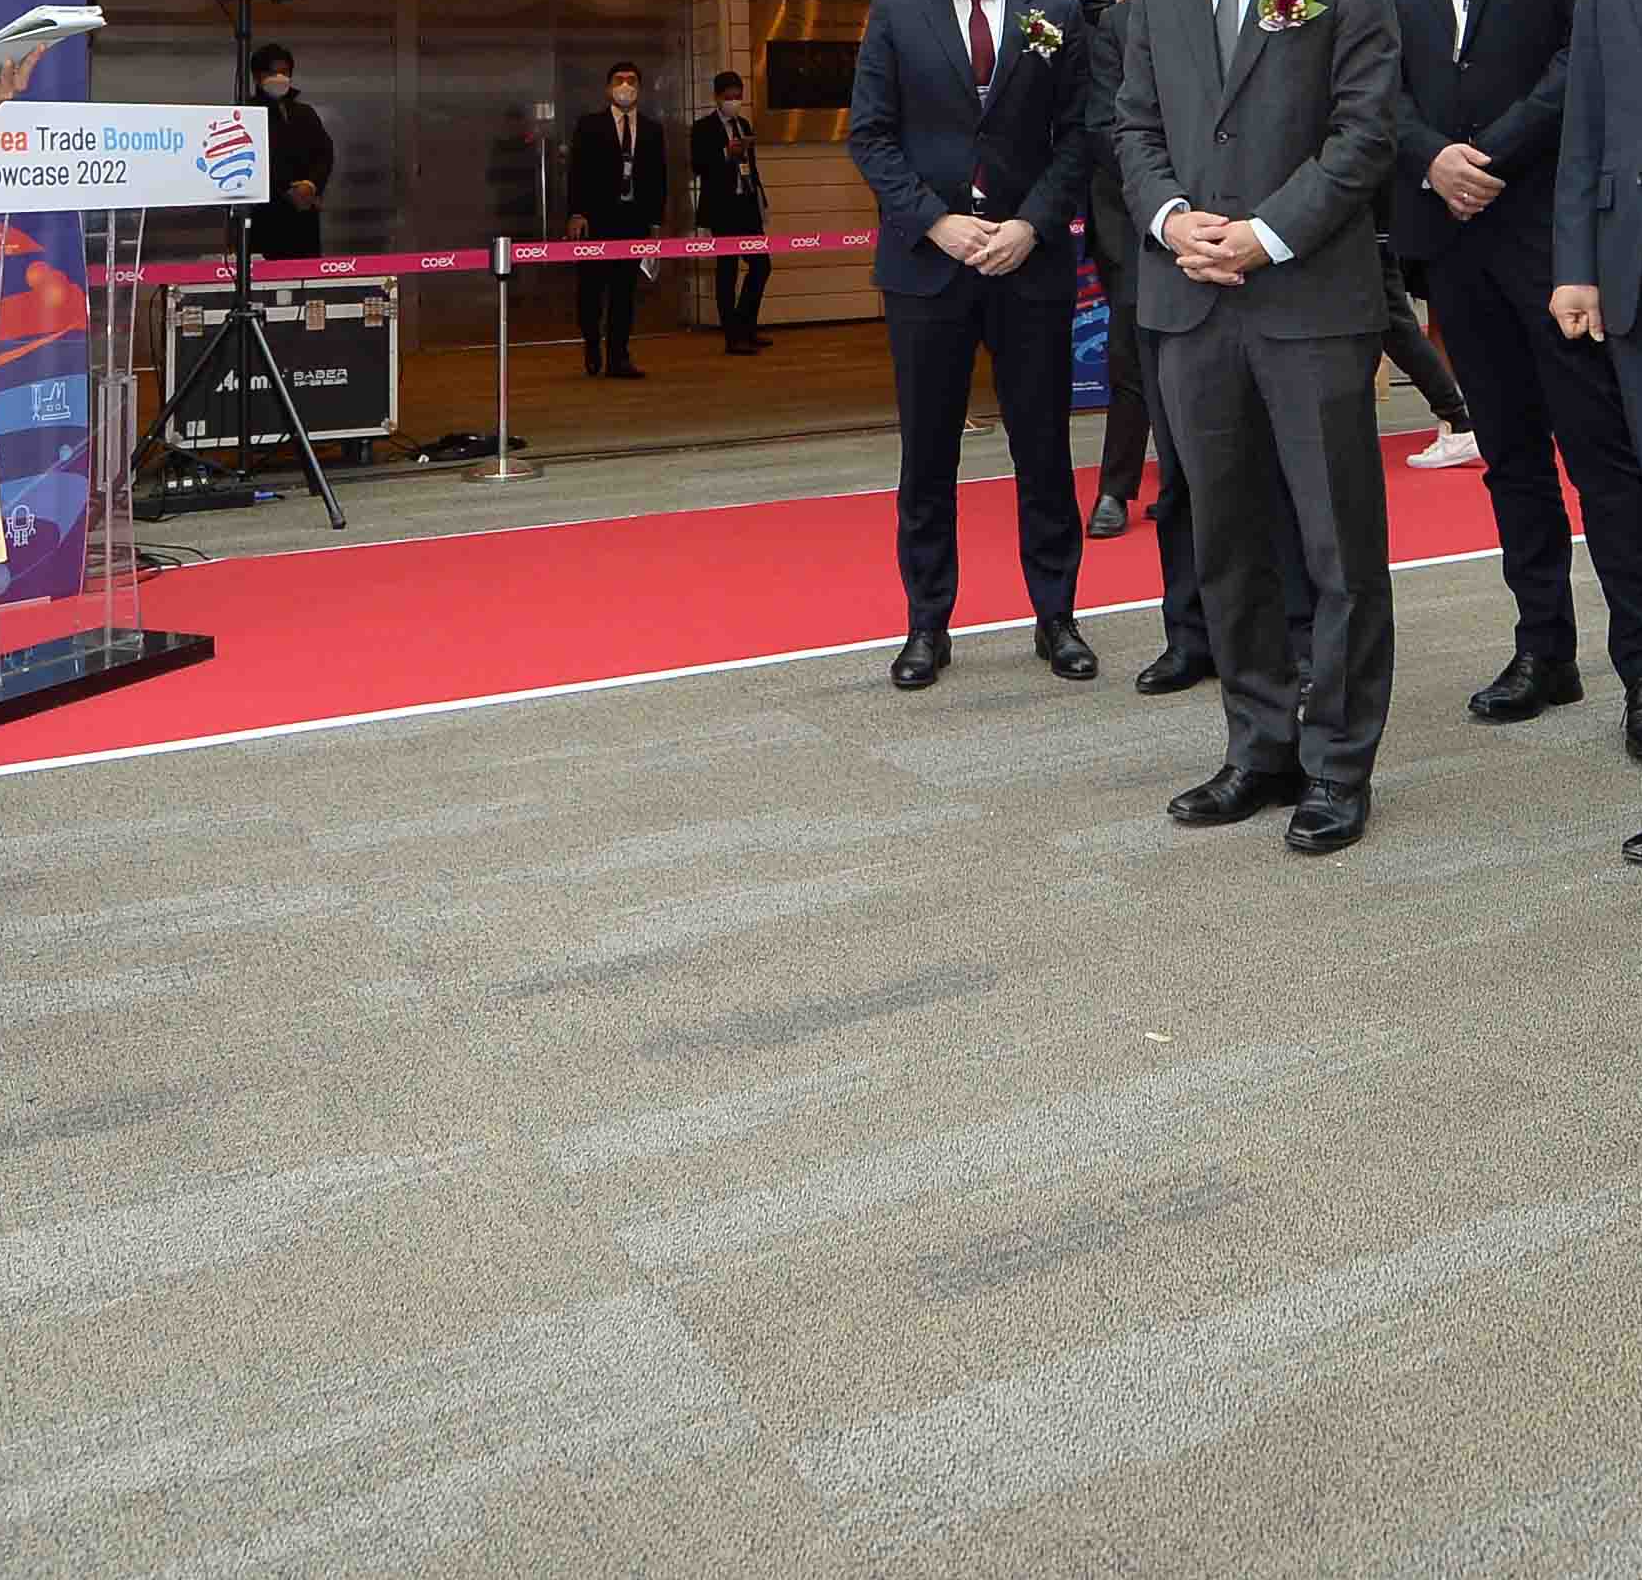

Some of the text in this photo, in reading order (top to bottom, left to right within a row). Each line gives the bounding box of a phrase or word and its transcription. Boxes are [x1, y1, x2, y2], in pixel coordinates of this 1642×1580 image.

[36, 126, 96, 151] Trade
[103, 127, 185, 155] BoomUp
[76, 160, 128, 185] 2022
[685, 237, 716, 253] coex
[739, 237, 769, 251] coex
[791, 234, 820, 249] coex
[842, 231, 870, 245] coex
[515, 244, 548, 259] coex
[573, 243, 606, 256] coex
[630, 240, 661, 255] coex
[320, 258, 357, 274] coex
[420, 252, 456, 269] coex
